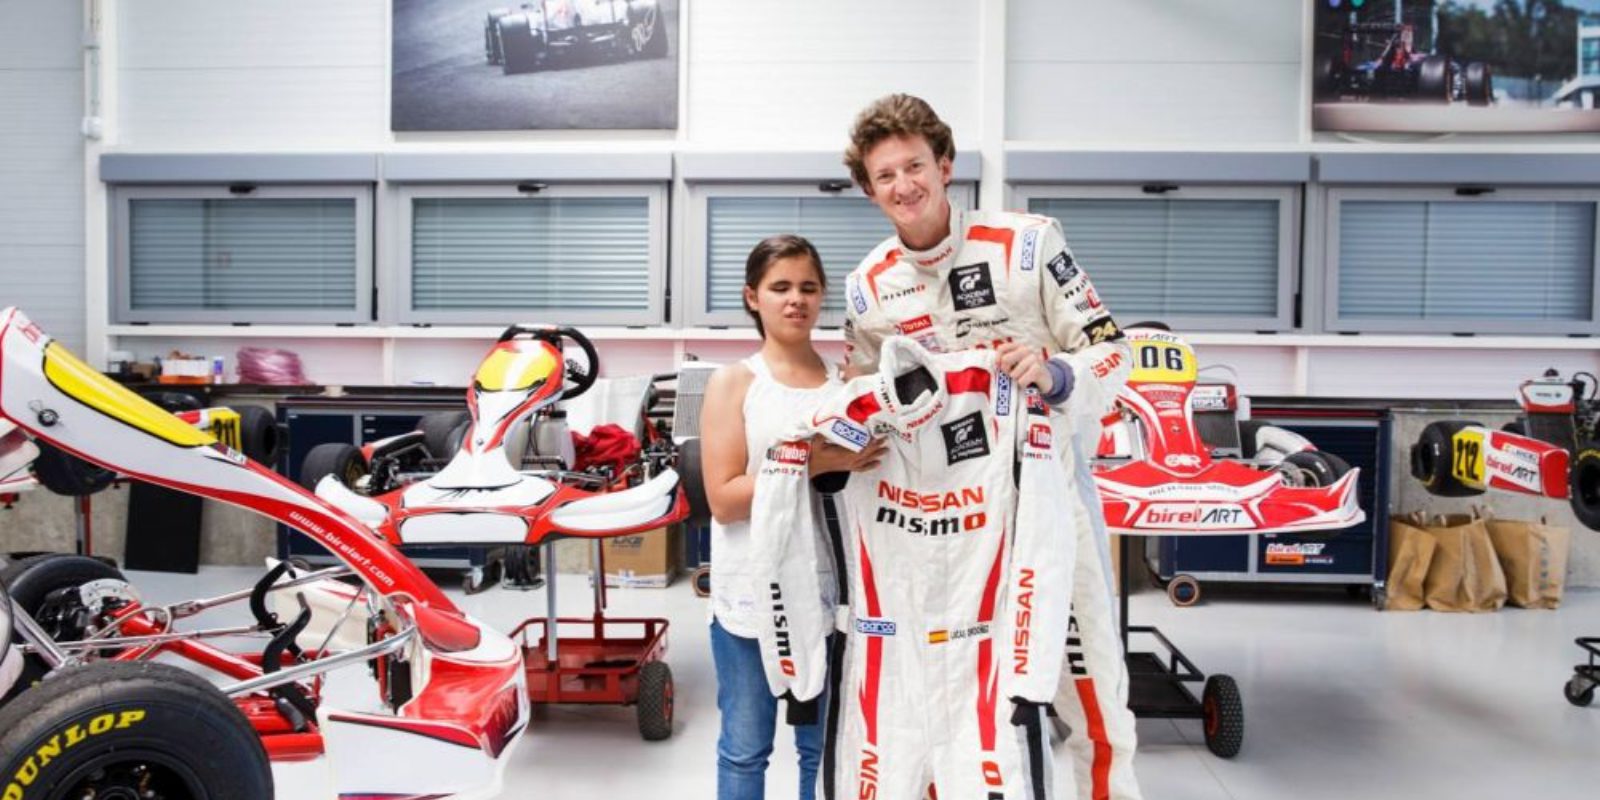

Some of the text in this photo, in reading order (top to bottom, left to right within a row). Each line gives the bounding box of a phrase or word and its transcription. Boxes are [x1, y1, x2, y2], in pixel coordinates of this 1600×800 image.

[1091, 321, 1116, 344] 24
[1132, 345, 1183, 371] 06
[1455, 438, 1480, 481] 212
[877, 480, 984, 513] NISSAN
[876, 506, 986, 537] nismo
[289, 511, 395, 588] www.birelart.com
[770, 583, 796, 677] nismo
[1013, 568, 1034, 676] NISSAN
[3, 709, 146, 800] DUNLOP
